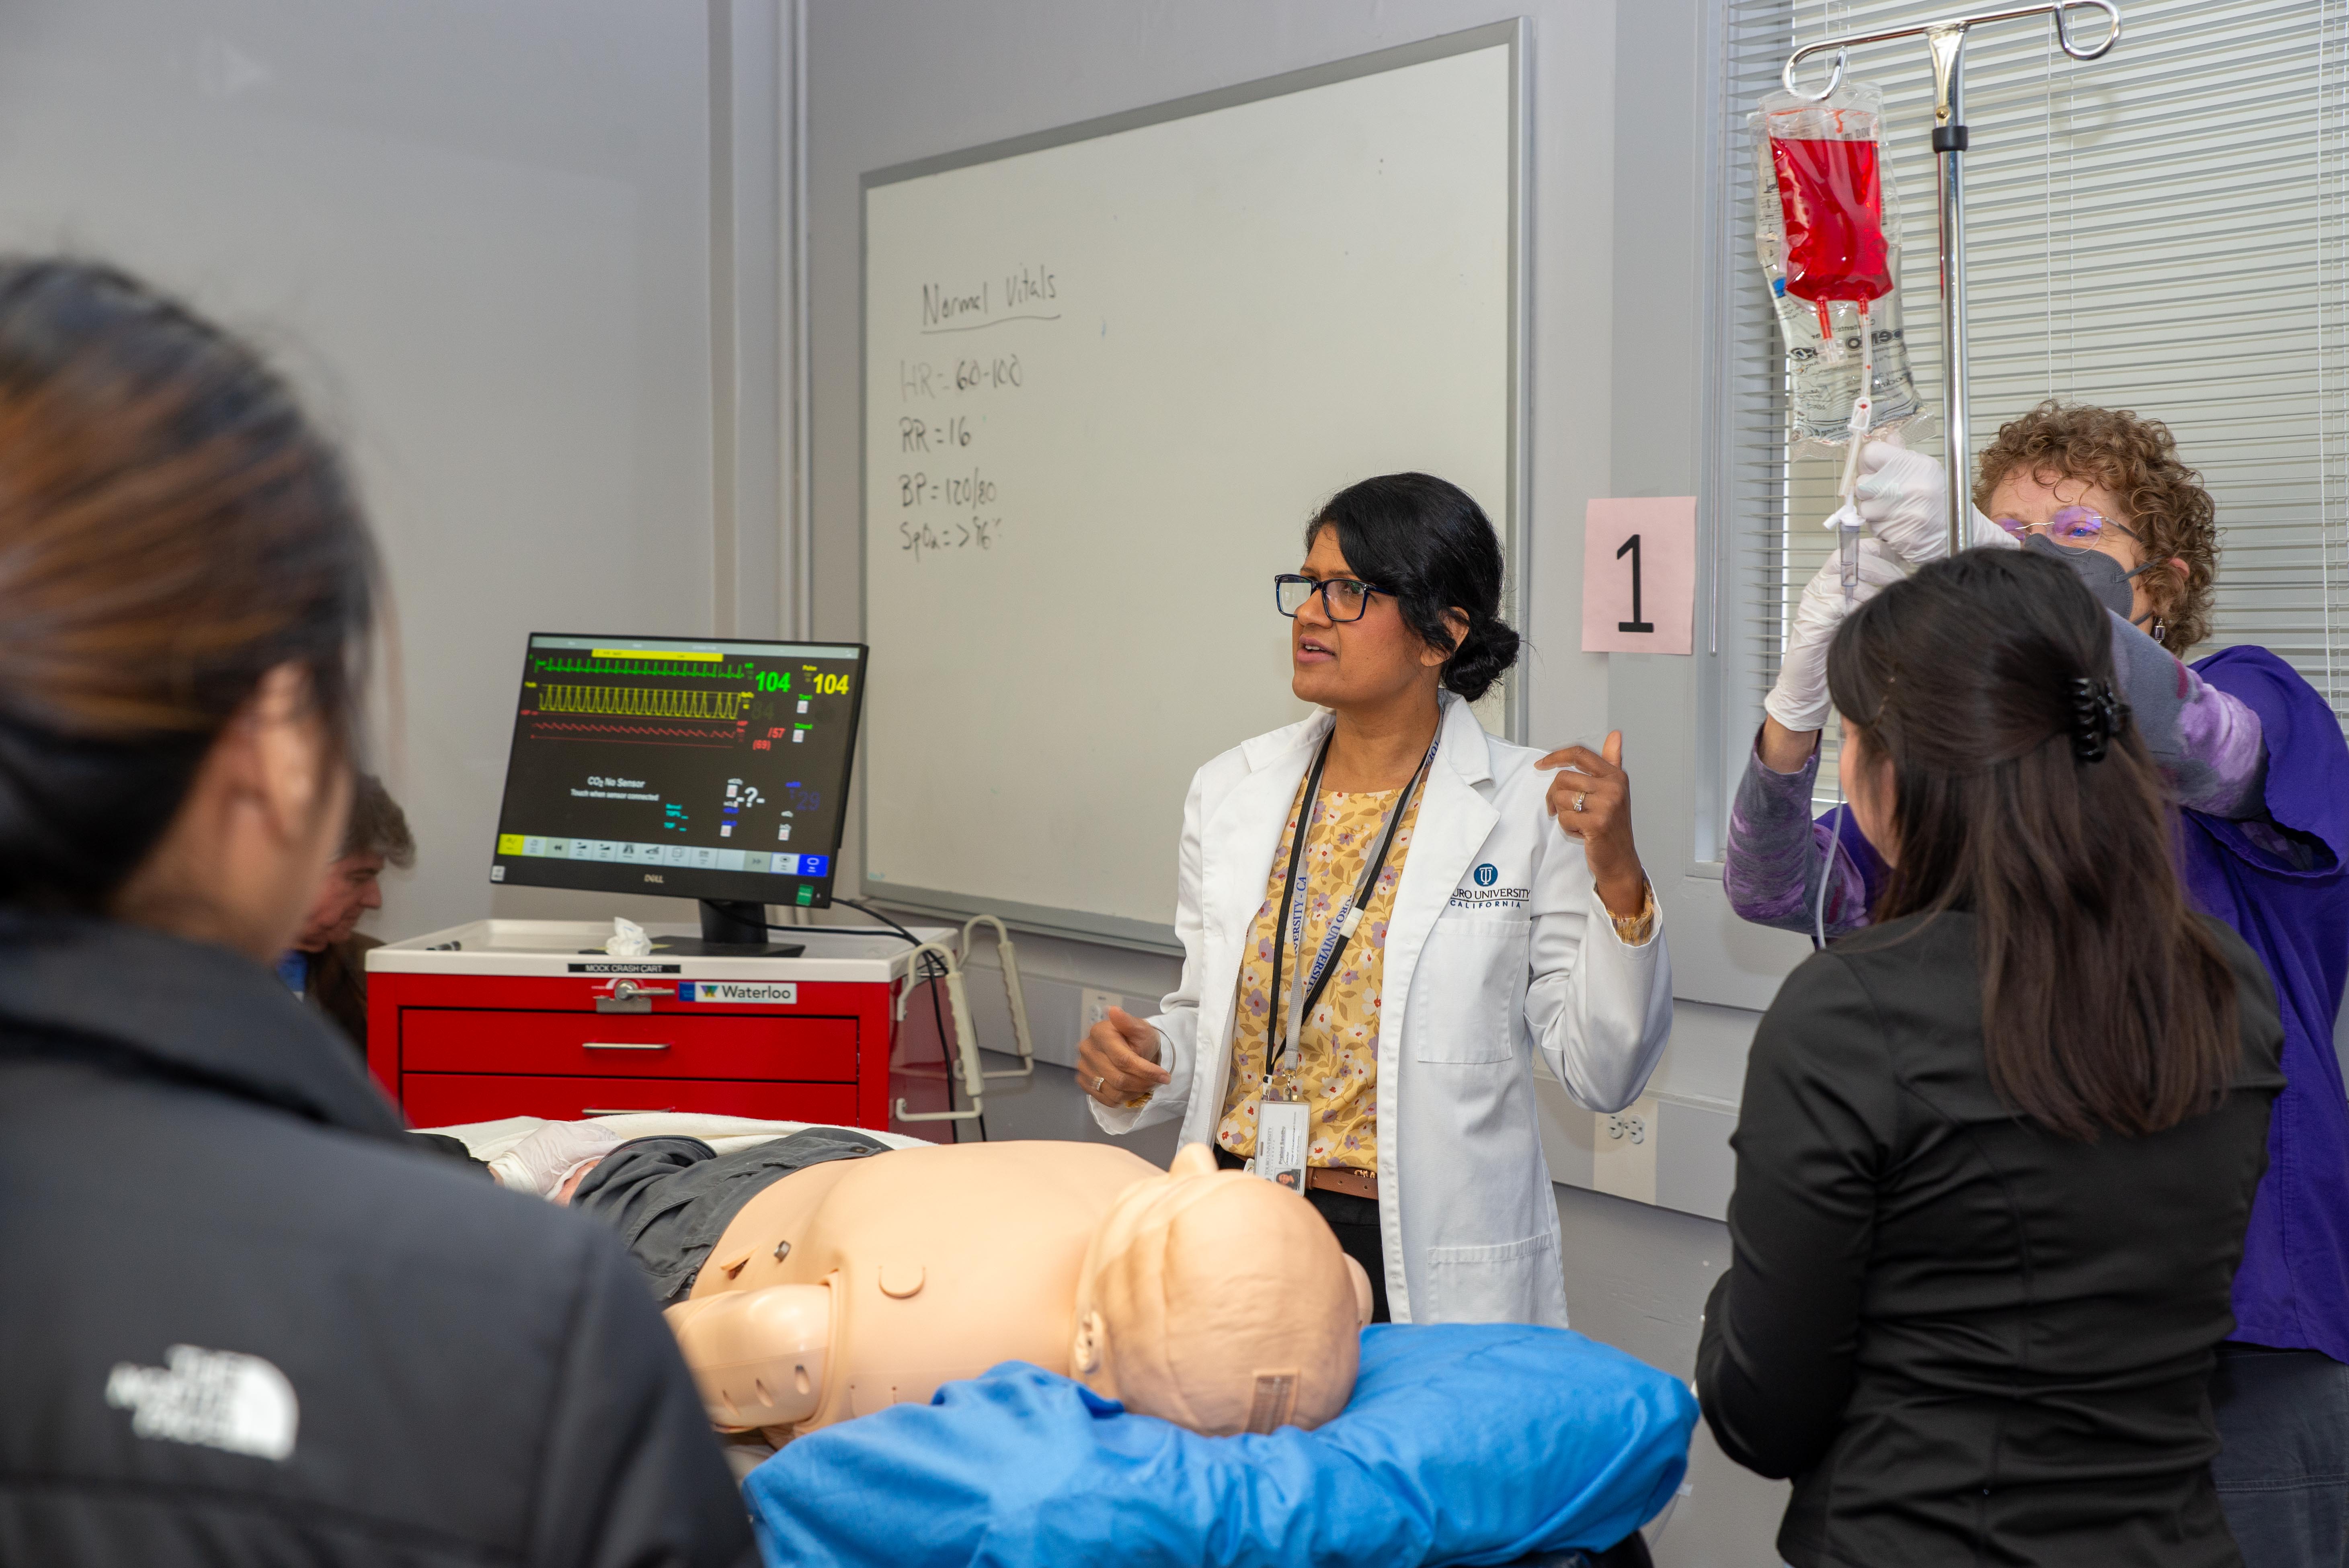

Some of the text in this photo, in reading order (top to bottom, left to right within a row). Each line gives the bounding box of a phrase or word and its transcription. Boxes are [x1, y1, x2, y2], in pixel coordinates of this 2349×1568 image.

[923, 264, 1057, 326] Normal Vitals
[1617, 534, 1654, 633] 1
[755, 671, 791, 693] 104
[813, 673, 849, 695] 104
[605, 777, 617, 787] No
[617, 777, 646, 788] Sensor
[644, 874, 664, 883] DELL
[1296, 876, 1307, 892] CA
[1452, 888, 1531, 900] URO UNIVERSITY
[1450, 900, 1521, 909] CALIFORNIA
[722, 985, 791, 999] Waterloo
